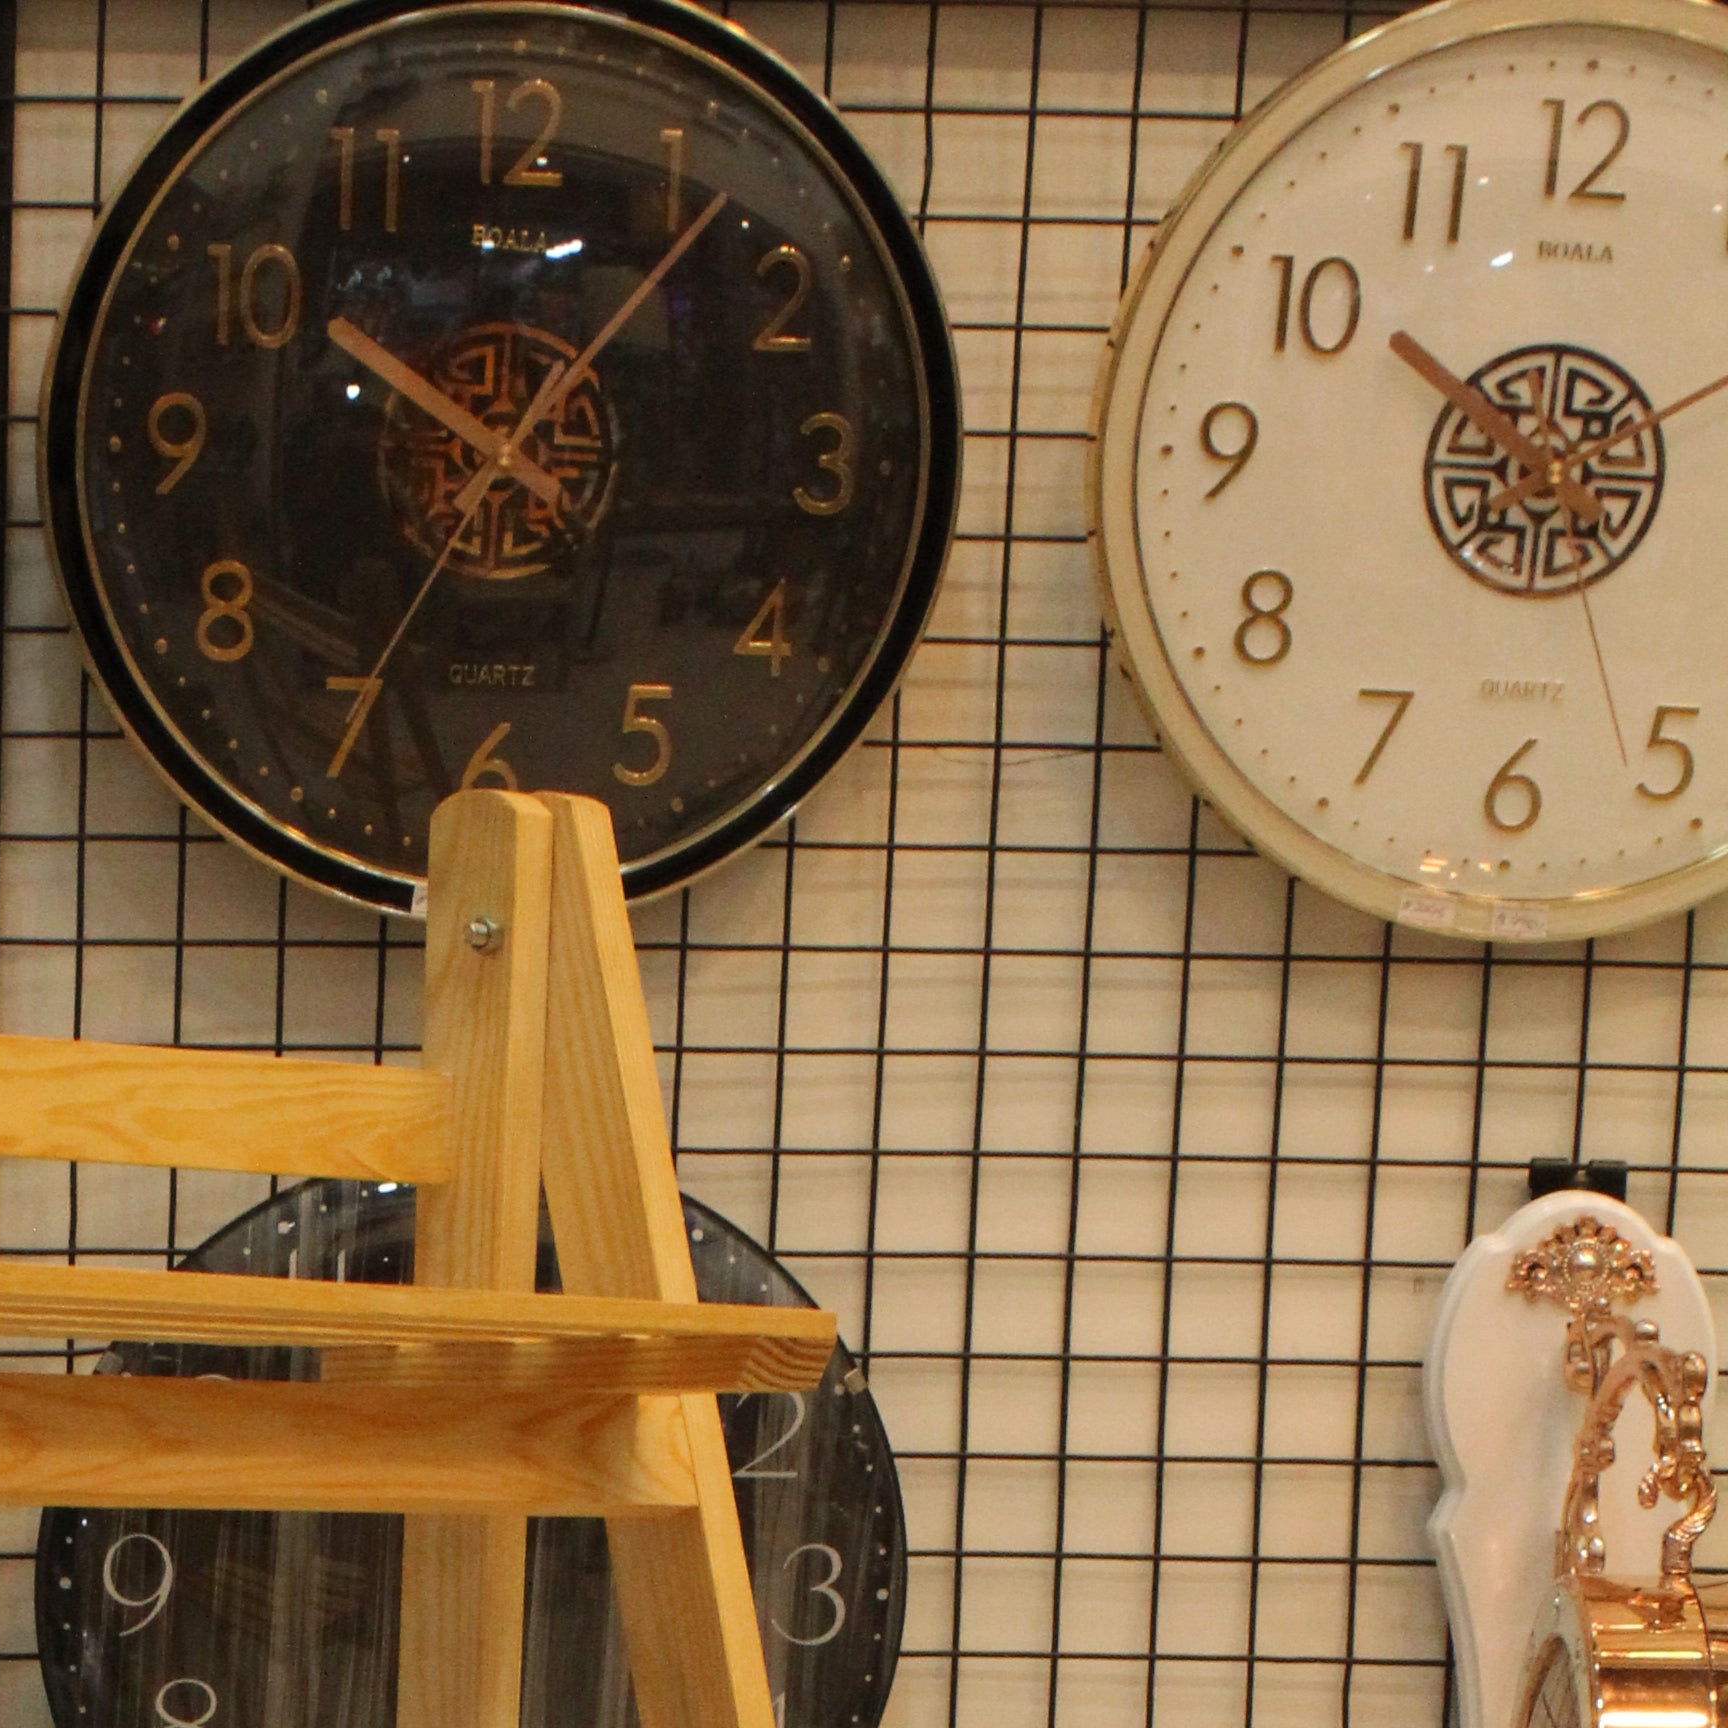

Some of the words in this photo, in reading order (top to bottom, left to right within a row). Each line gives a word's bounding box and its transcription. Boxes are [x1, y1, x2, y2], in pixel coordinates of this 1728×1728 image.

[331, 127, 400, 232] 11
[472, 78, 563, 186] 12
[660, 129, 685, 232] 1
[1543, 98, 1631, 202] 12
[1401, 141, 1468, 243] 11
[207, 243, 302, 349] 10
[753, 246, 812, 352] 2
[1271, 254, 1362, 355] 10
[148, 392, 207, 495] 9
[792, 412, 852, 515] 3
[1199, 401, 1260, 500] 9
[196, 559, 255, 662] 8
[732, 579, 792, 677] 4
[1234, 569, 1294, 666] 8
[450, 664, 535, 687] QUARTZ
[1478, 678, 1565, 703] QUARTZ
[326, 676, 383, 778] 7
[612, 685, 673, 787] 5
[1358, 689, 1415, 785] 7
[1636, 706, 1700, 801] 5
[1483, 737, 1543, 833] 6
[734, 1392, 806, 1480] 2
[103, 1533, 173, 1638] 9
[770, 1543, 847, 1646] 3
